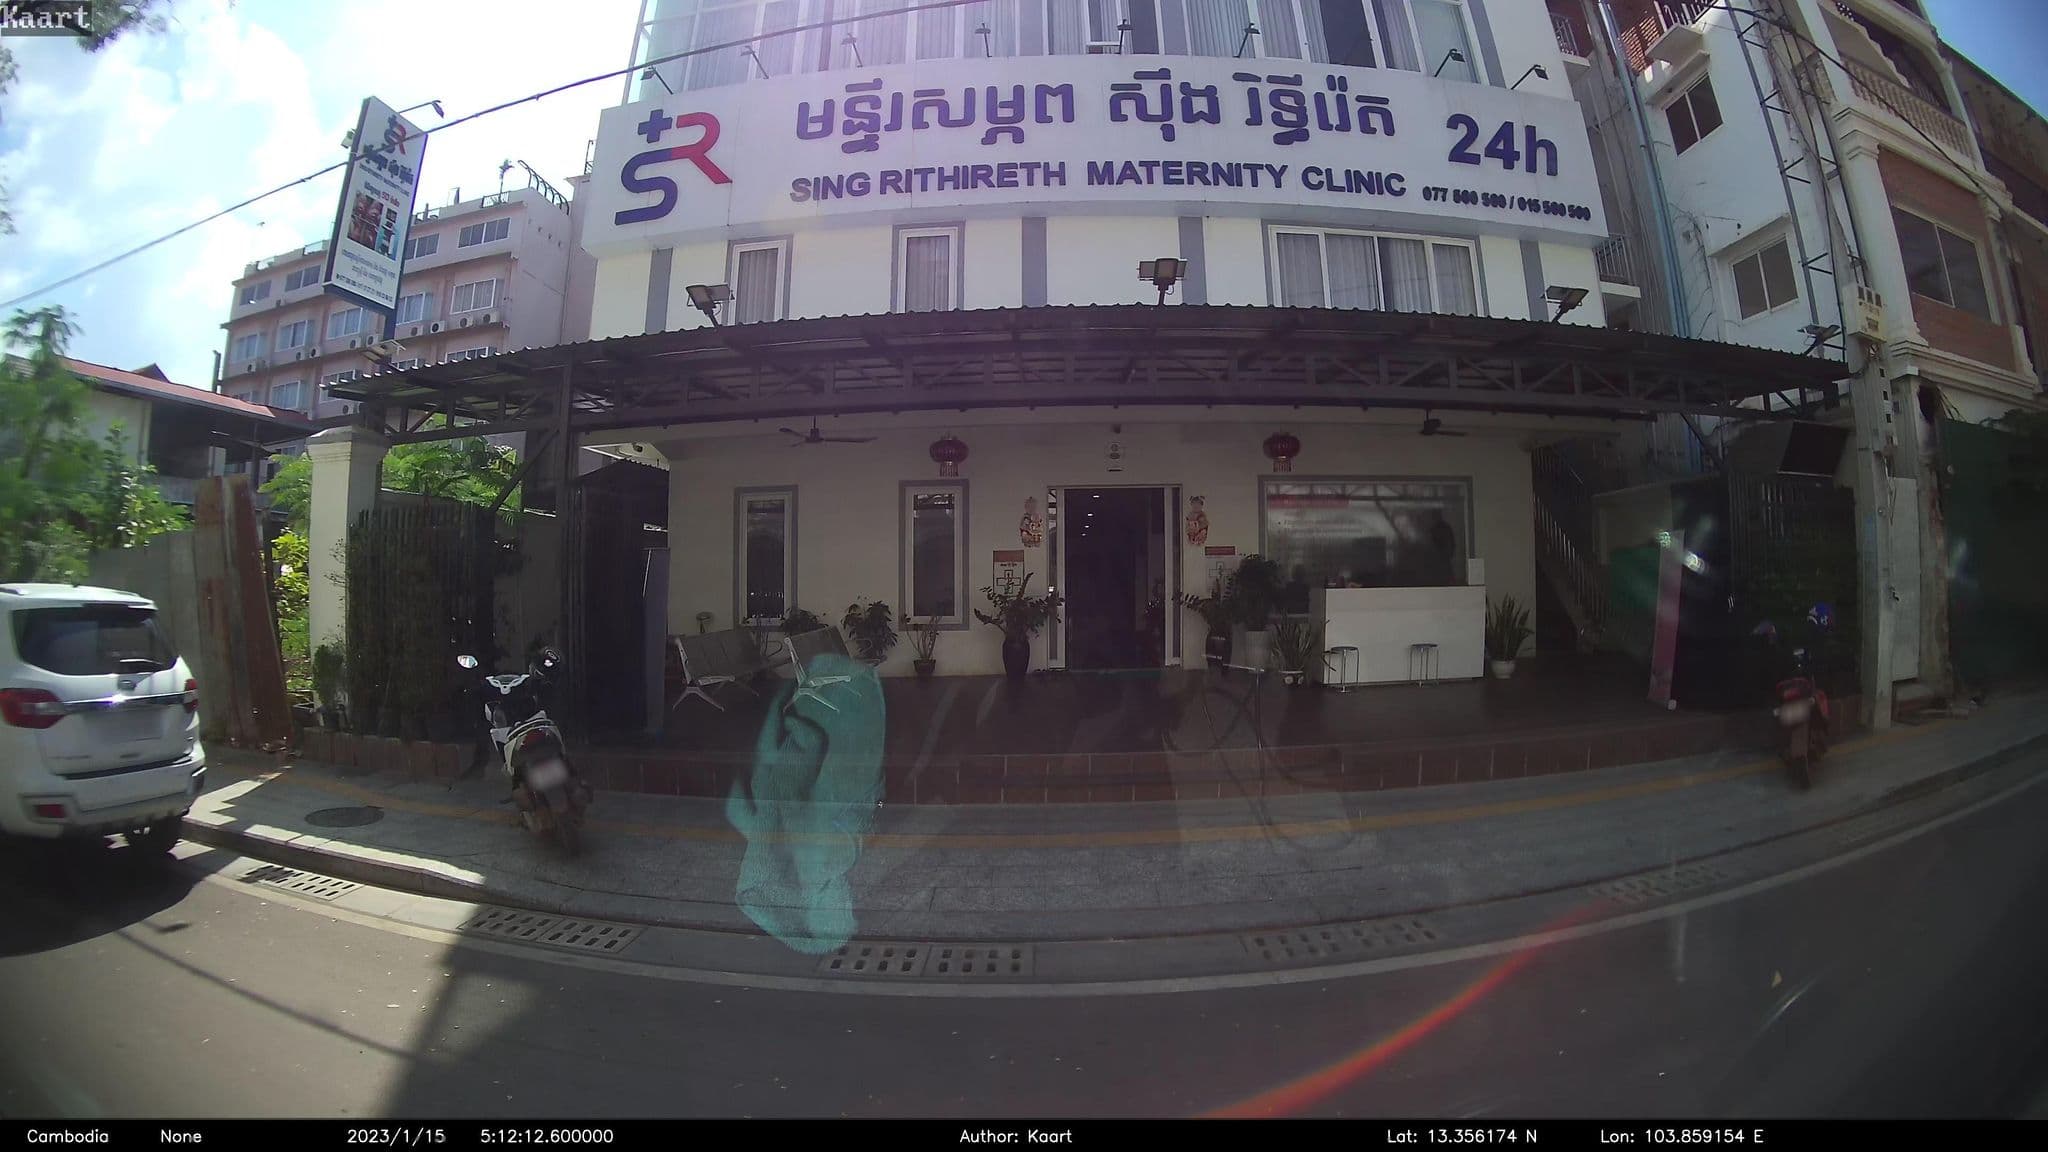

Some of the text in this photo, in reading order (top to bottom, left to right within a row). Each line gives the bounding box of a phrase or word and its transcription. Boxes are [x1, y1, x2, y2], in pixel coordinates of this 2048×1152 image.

[1446, 113, 1558, 176] 24h
[789, 160, 1407, 203] SING RITHIRETH MATERNITY CLINIC
